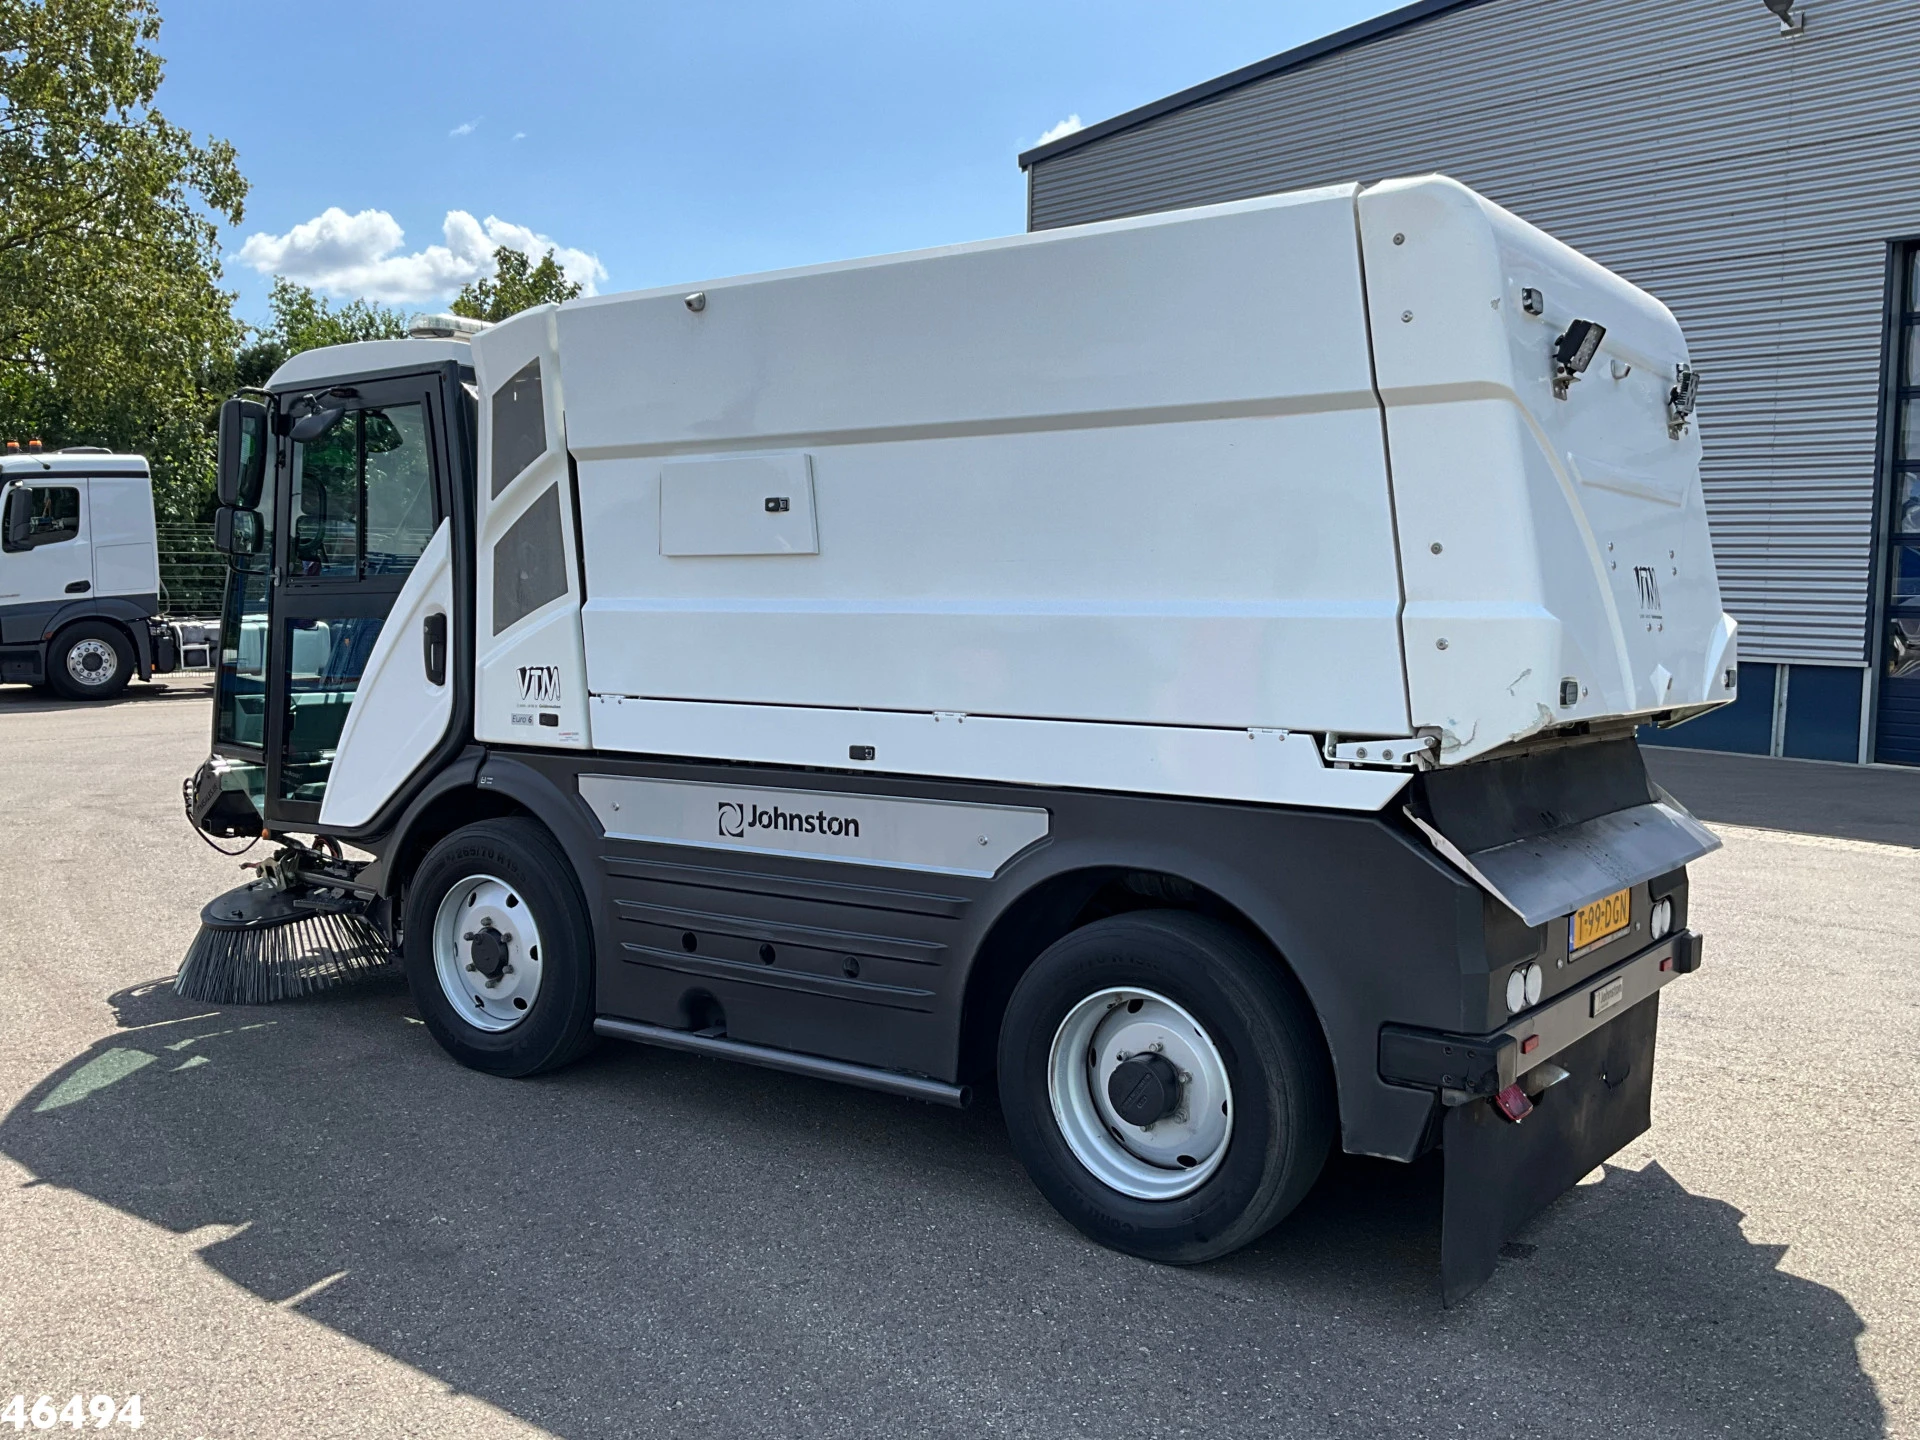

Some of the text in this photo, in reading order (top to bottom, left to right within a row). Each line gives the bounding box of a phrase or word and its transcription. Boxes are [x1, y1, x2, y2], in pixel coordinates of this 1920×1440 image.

[516, 665, 561, 701] VTM
[511, 714, 533, 724] Euro 6
[748, 804, 860, 837] Johnston
[1577, 892, 1628, 942] T-99-DGN
